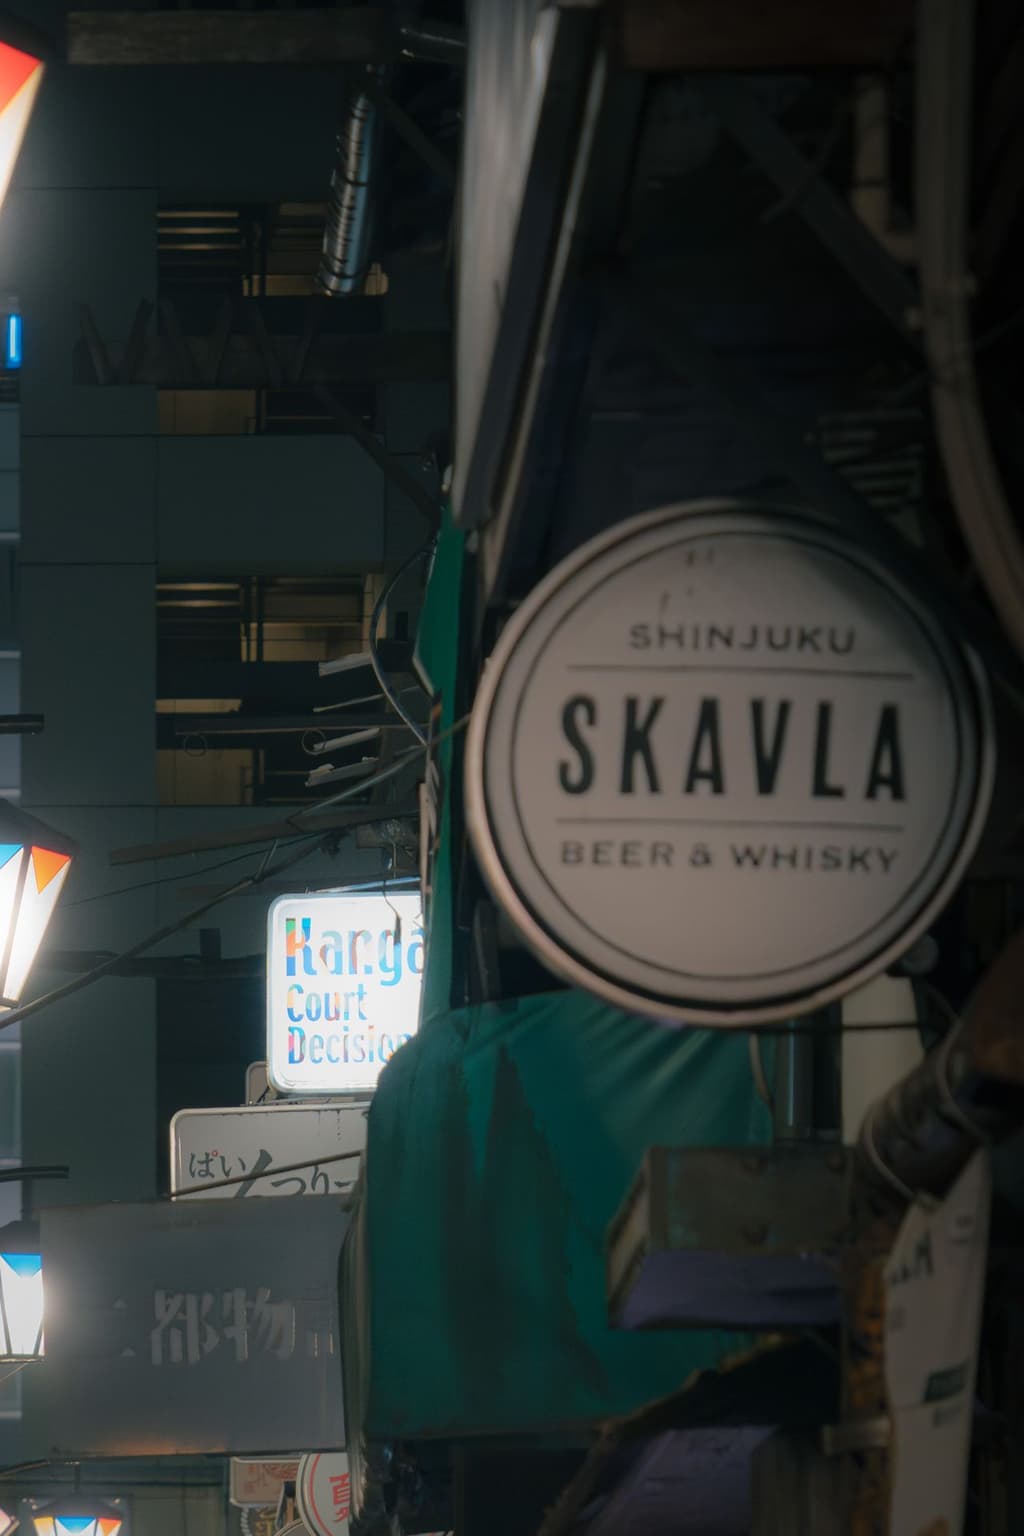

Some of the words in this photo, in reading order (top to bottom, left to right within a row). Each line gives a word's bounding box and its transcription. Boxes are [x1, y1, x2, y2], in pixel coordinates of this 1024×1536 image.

[628, 622, 858, 656] SHINJUKU
[558, 693, 907, 801] SKAVLA
[560, 839, 675, 867] BEER
[689, 844, 713, 868] &
[728, 844, 900, 874] WHISKY
[286, 983, 368, 1022] Court
